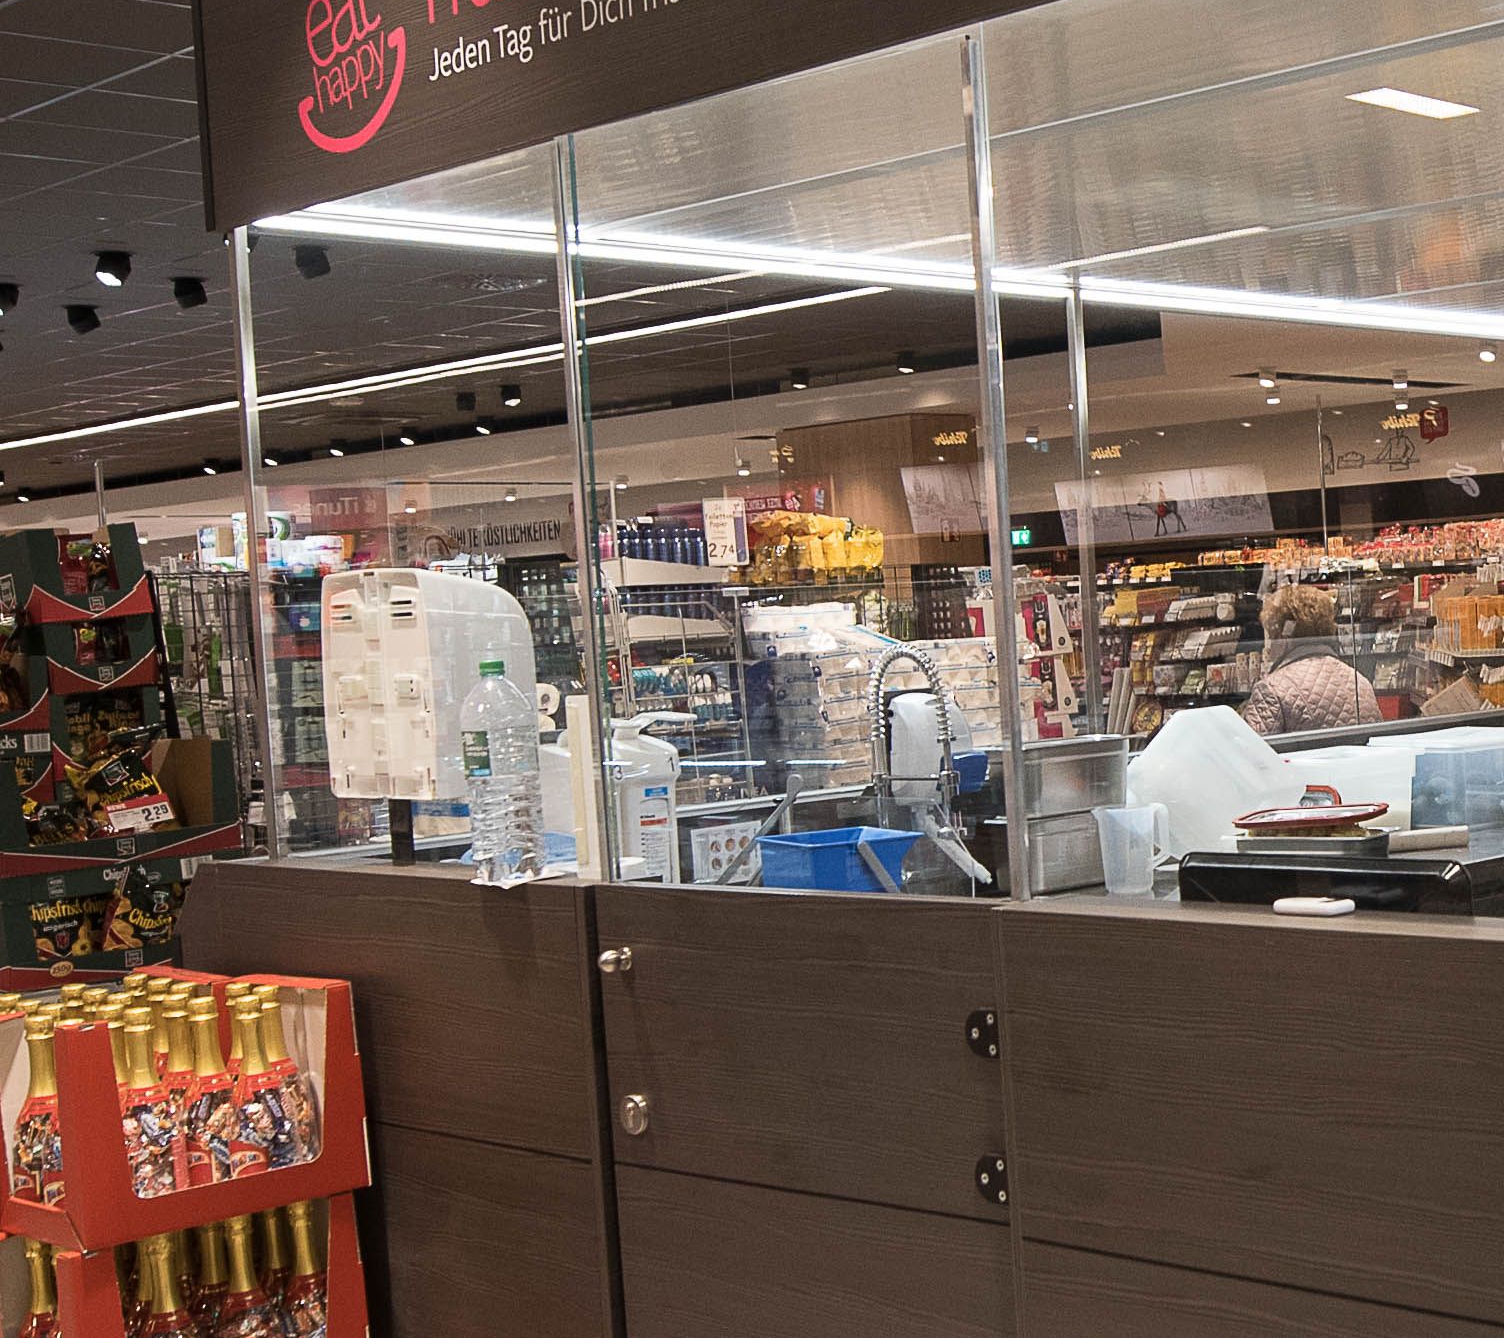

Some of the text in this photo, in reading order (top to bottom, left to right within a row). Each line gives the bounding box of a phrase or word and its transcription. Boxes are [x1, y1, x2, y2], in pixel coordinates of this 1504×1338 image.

[312, 38, 387, 116] happy
[428, 34, 491, 82] Jeden
[493, 22, 534, 63] Tag
[538, 6, 572, 46] für
